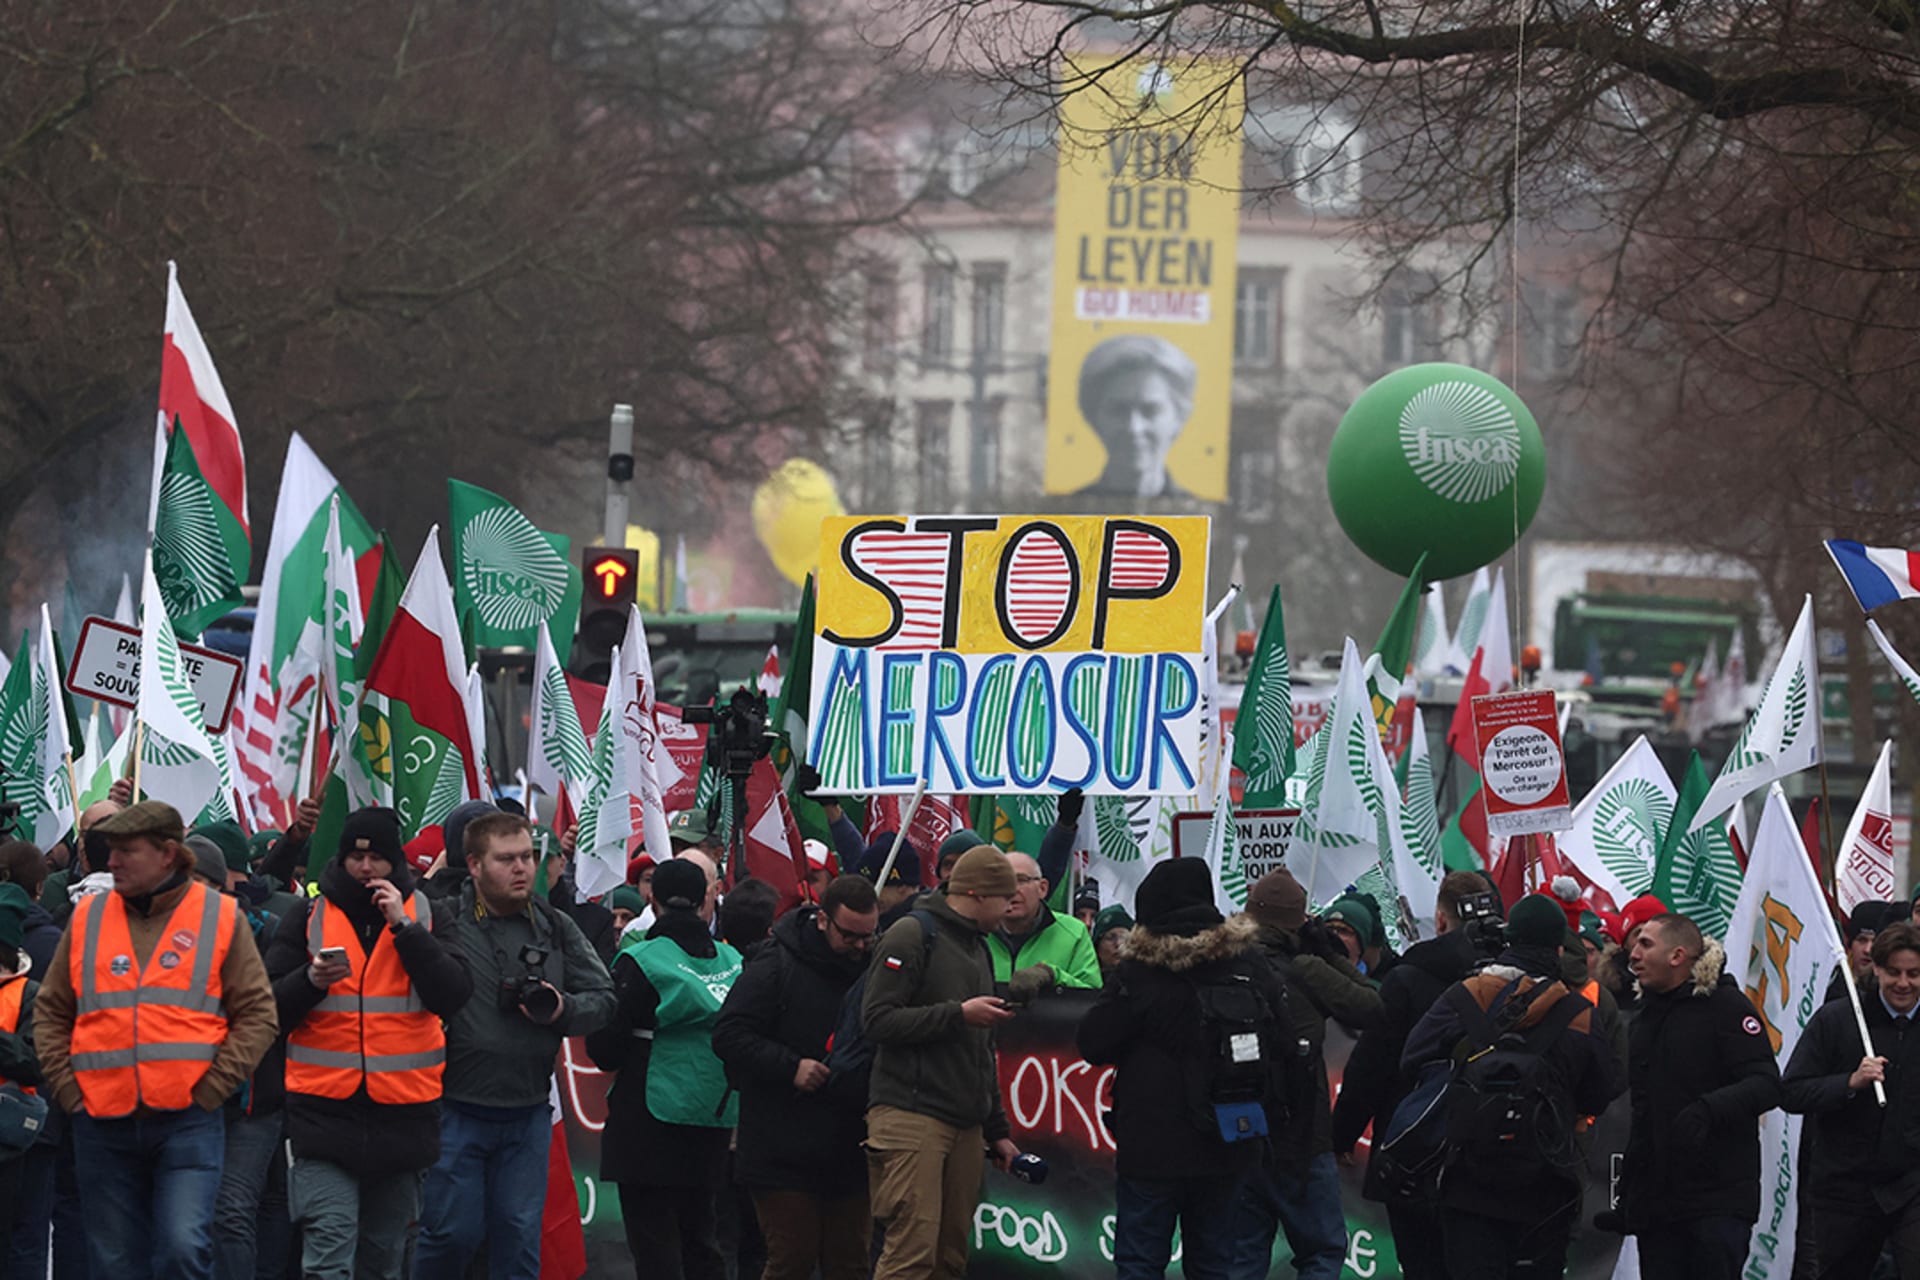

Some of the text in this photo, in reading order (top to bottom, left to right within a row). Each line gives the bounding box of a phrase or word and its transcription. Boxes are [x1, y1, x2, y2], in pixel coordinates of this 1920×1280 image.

[1109, 131, 1194, 180] VON
[1108, 185, 1189, 230] DER
[1078, 234, 1213, 287] LEYEN
[1083, 288, 1203, 318] GO HOME
[820, 517, 1182, 651] STOP
[806, 645, 1199, 791] MERCOSUR
[1493, 734, 1548, 748] Exigeons
[1532, 744, 1548, 756] du
[1492, 758, 1547, 772] Mercosur
[1512, 774, 1538, 785] On va
[1259, 822, 1295, 839] AUX
